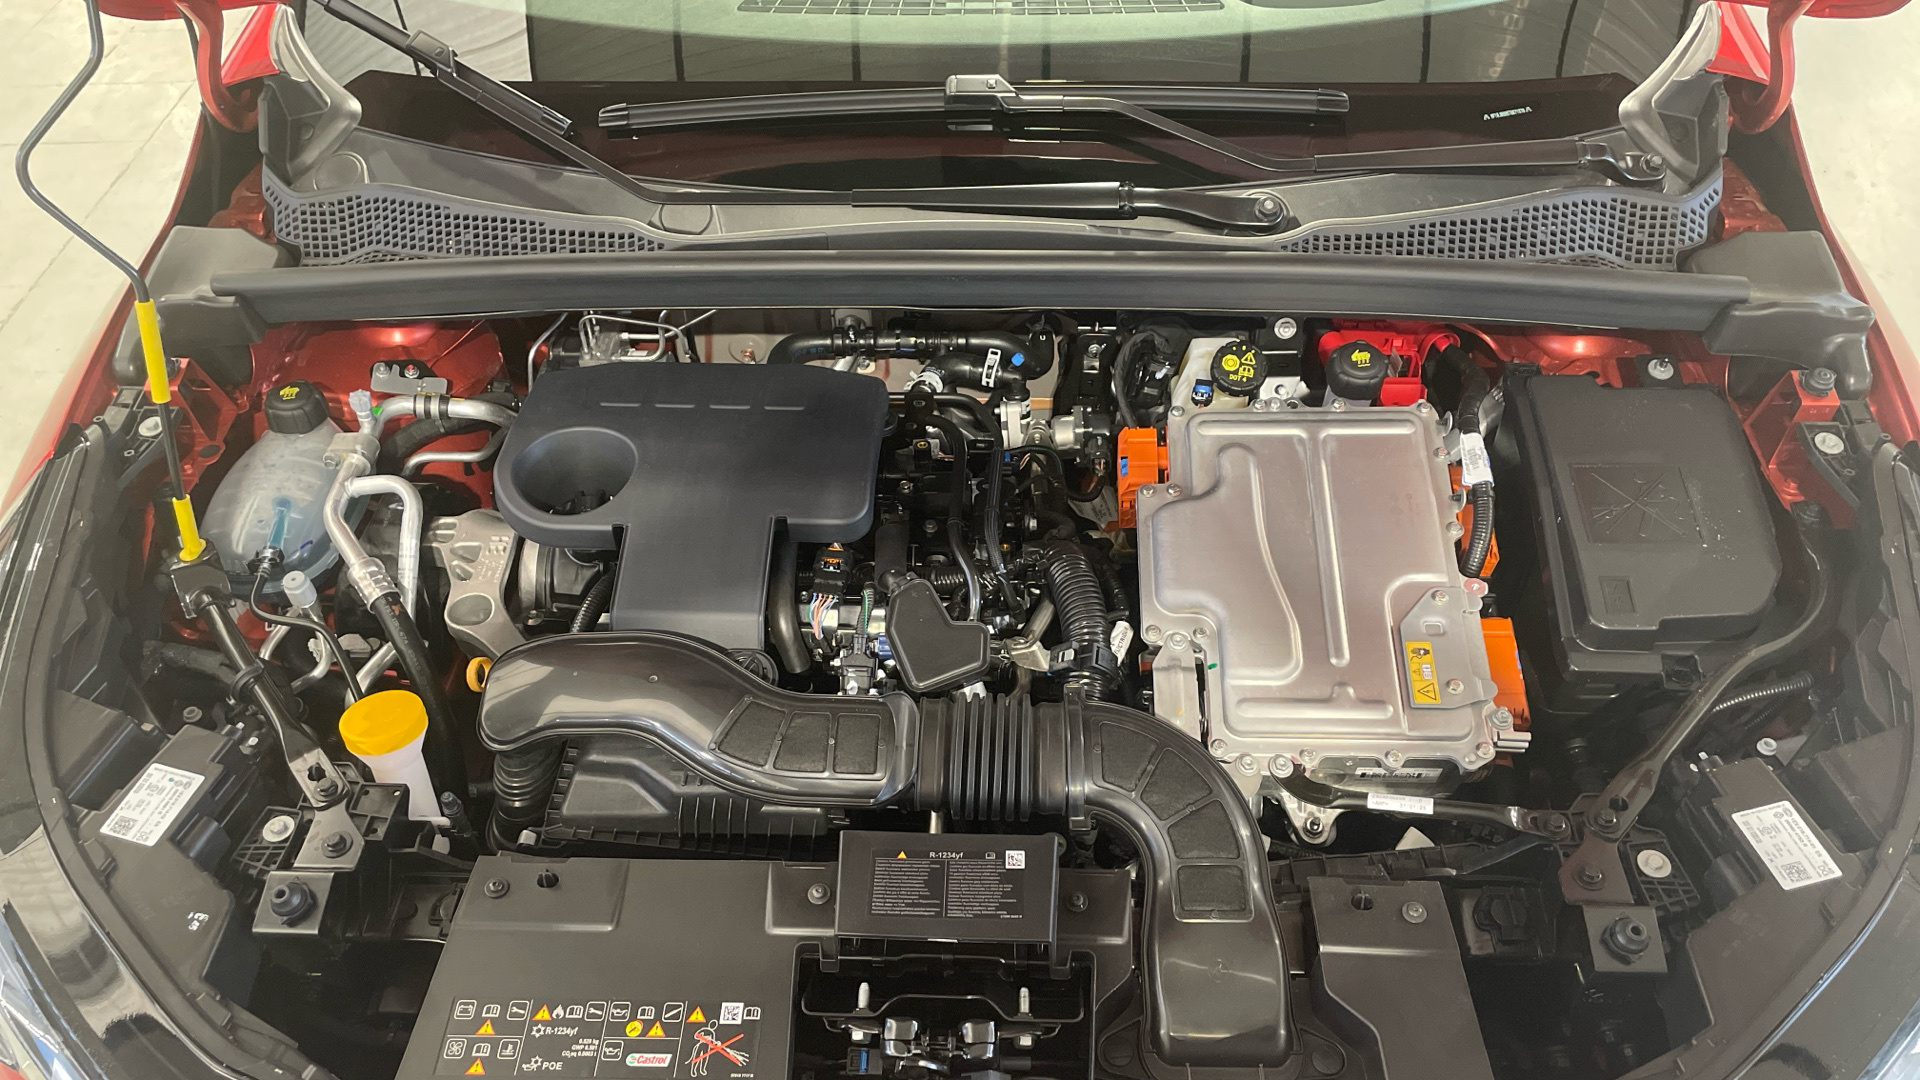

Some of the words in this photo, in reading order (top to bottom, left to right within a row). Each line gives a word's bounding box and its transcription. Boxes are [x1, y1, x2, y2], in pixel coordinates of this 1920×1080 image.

[929, 851, 964, 861] R-1234yf
[545, 1026, 579, 1037] R-1234yf
[592, 1038, 600, 1046] kg
[636, 1055, 668, 1064] Castrol
[542, 1061, 564, 1071] POE
